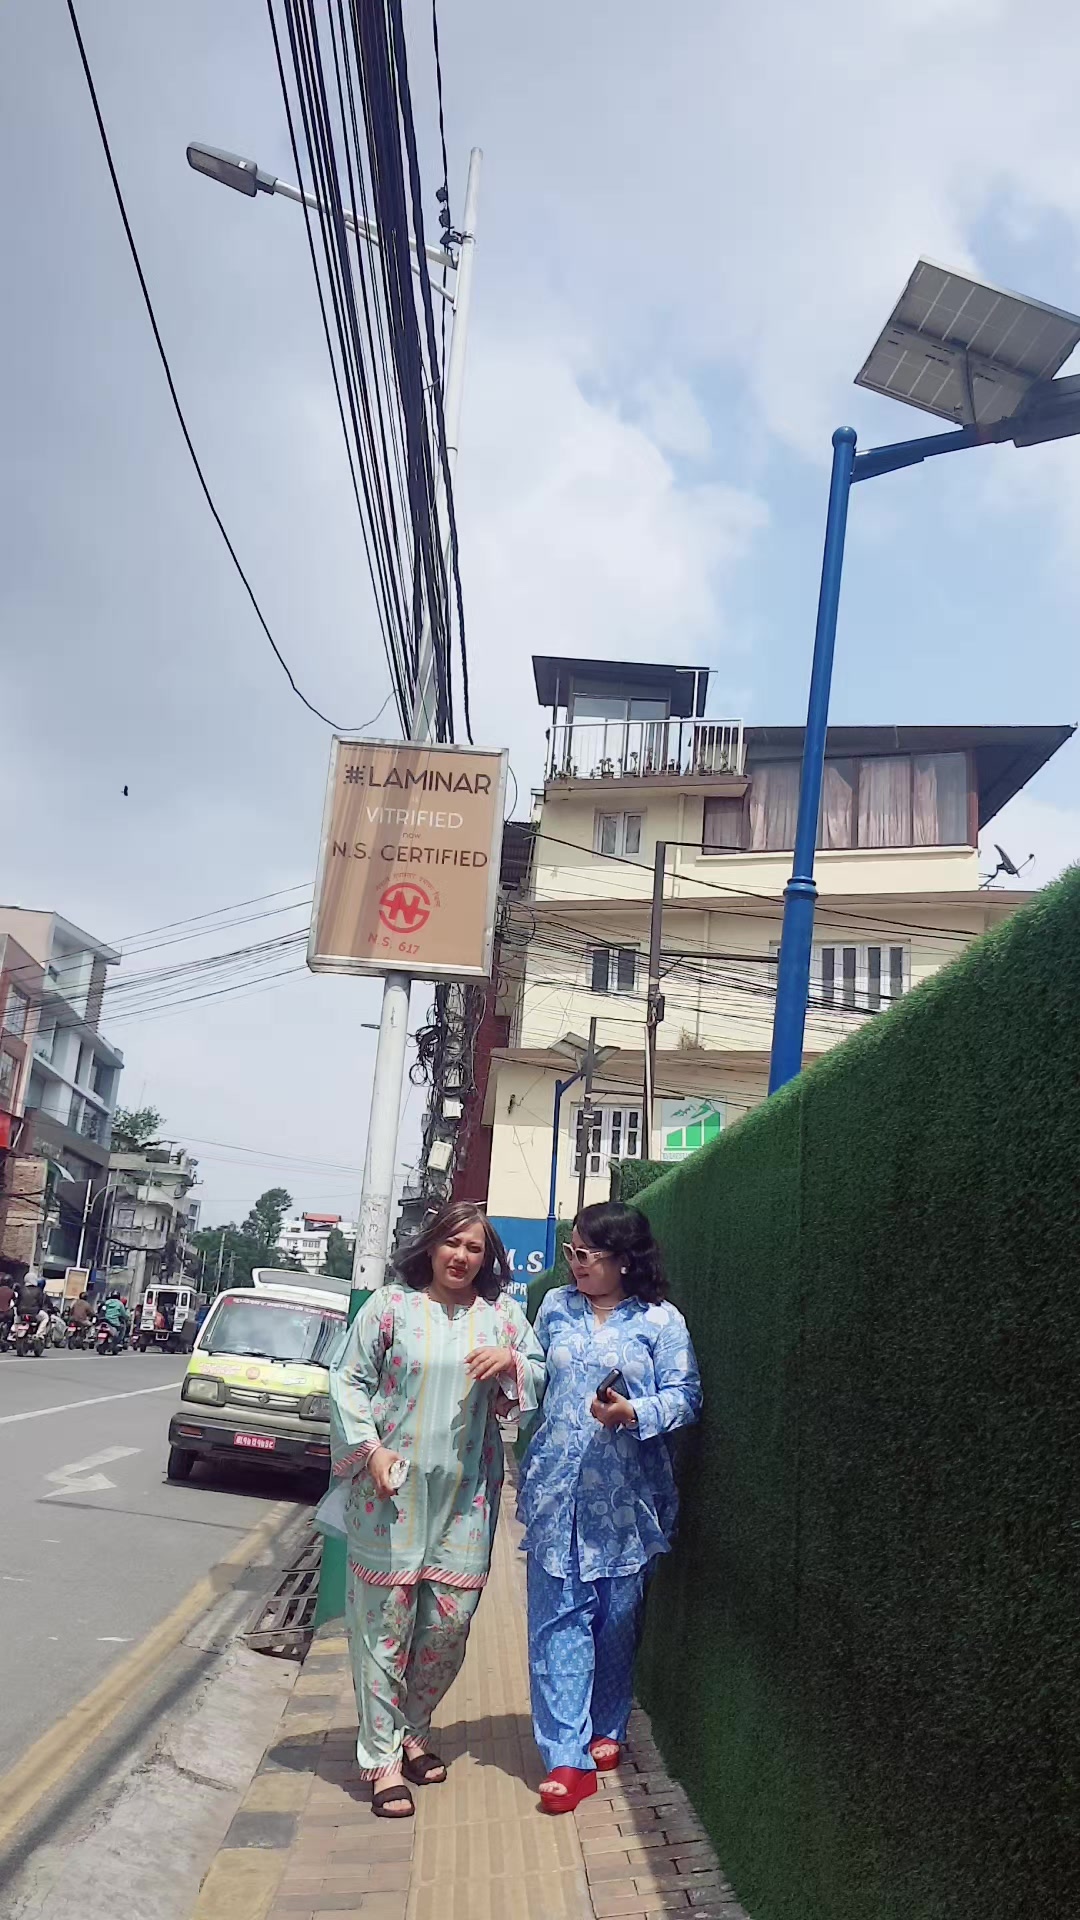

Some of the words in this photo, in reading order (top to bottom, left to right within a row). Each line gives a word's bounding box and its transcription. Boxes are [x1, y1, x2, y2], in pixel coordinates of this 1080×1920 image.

[366, 806, 464, 829] VITRIFIED
[332, 841, 371, 860] N.S.
[380, 844, 488, 868] CERTIFIED
[398, 941, 420, 955] 617
